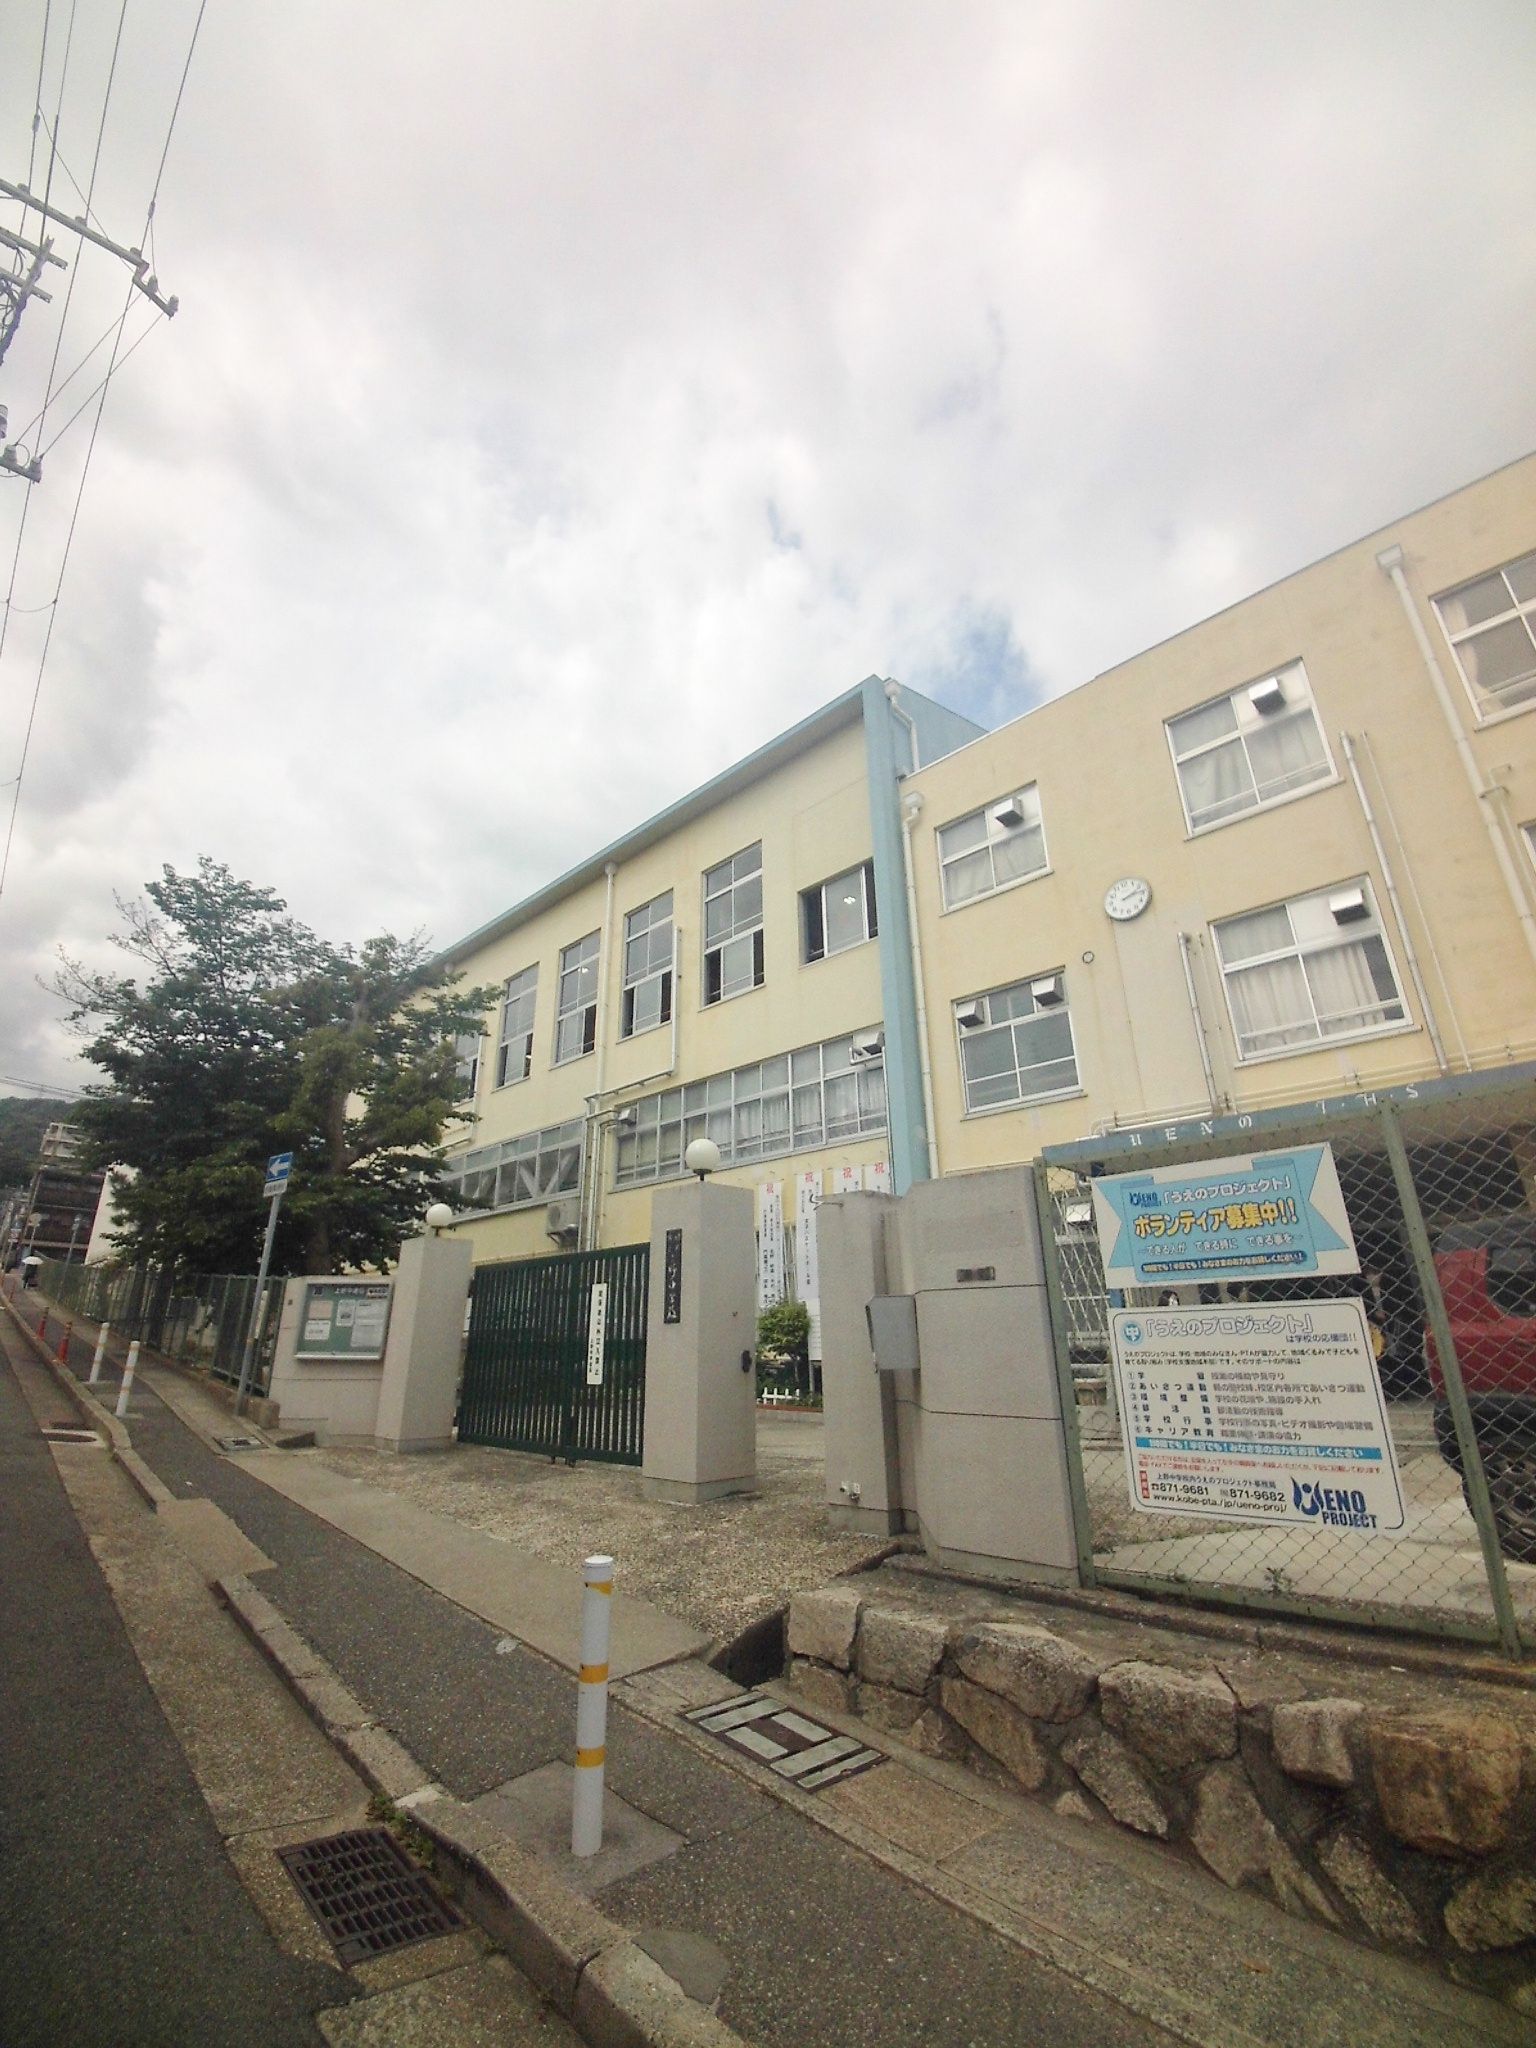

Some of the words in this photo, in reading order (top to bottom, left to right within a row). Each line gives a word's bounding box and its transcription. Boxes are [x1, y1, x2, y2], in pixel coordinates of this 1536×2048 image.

[843, 1167, 852, 1179] 祝
[875, 1161, 885, 1174] 祝
[804, 1171, 814, 1183] 祝
[1160, 1482, 1210, 1496] 871-9681
[1230, 1487, 1286, 1502] 871-9682
[1321, 1511, 1378, 1529] PROJECT
